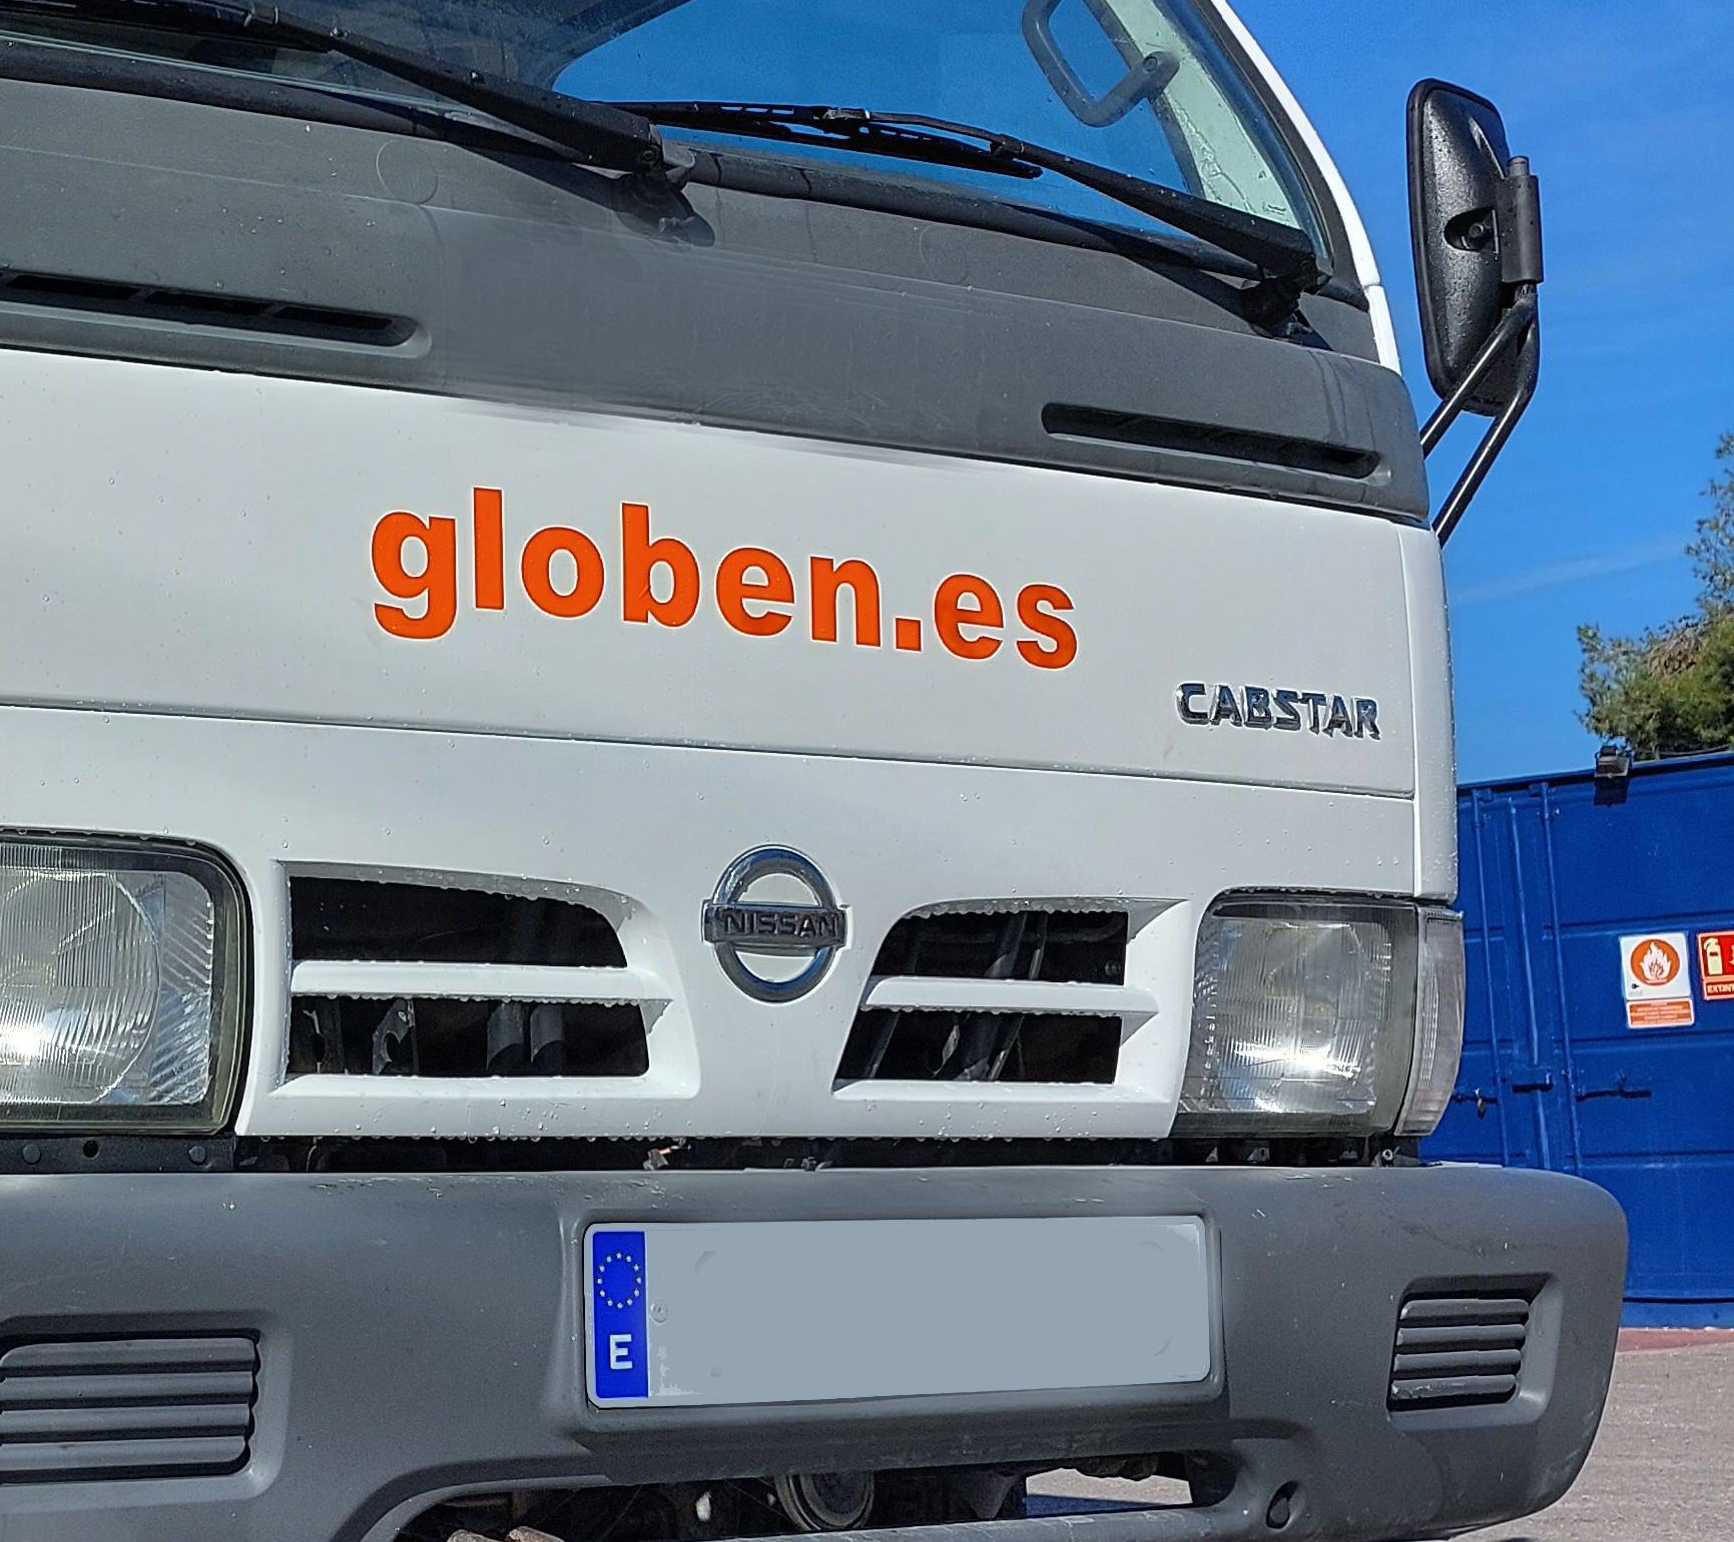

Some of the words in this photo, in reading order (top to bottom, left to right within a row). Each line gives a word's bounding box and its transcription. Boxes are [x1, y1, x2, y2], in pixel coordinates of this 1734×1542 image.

[371, 487, 1077, 670] globen.es
[1176, 682, 1381, 741] CABSTAR
[723, 911, 839, 938] NISSAN
[609, 1333, 633, 1370] E
